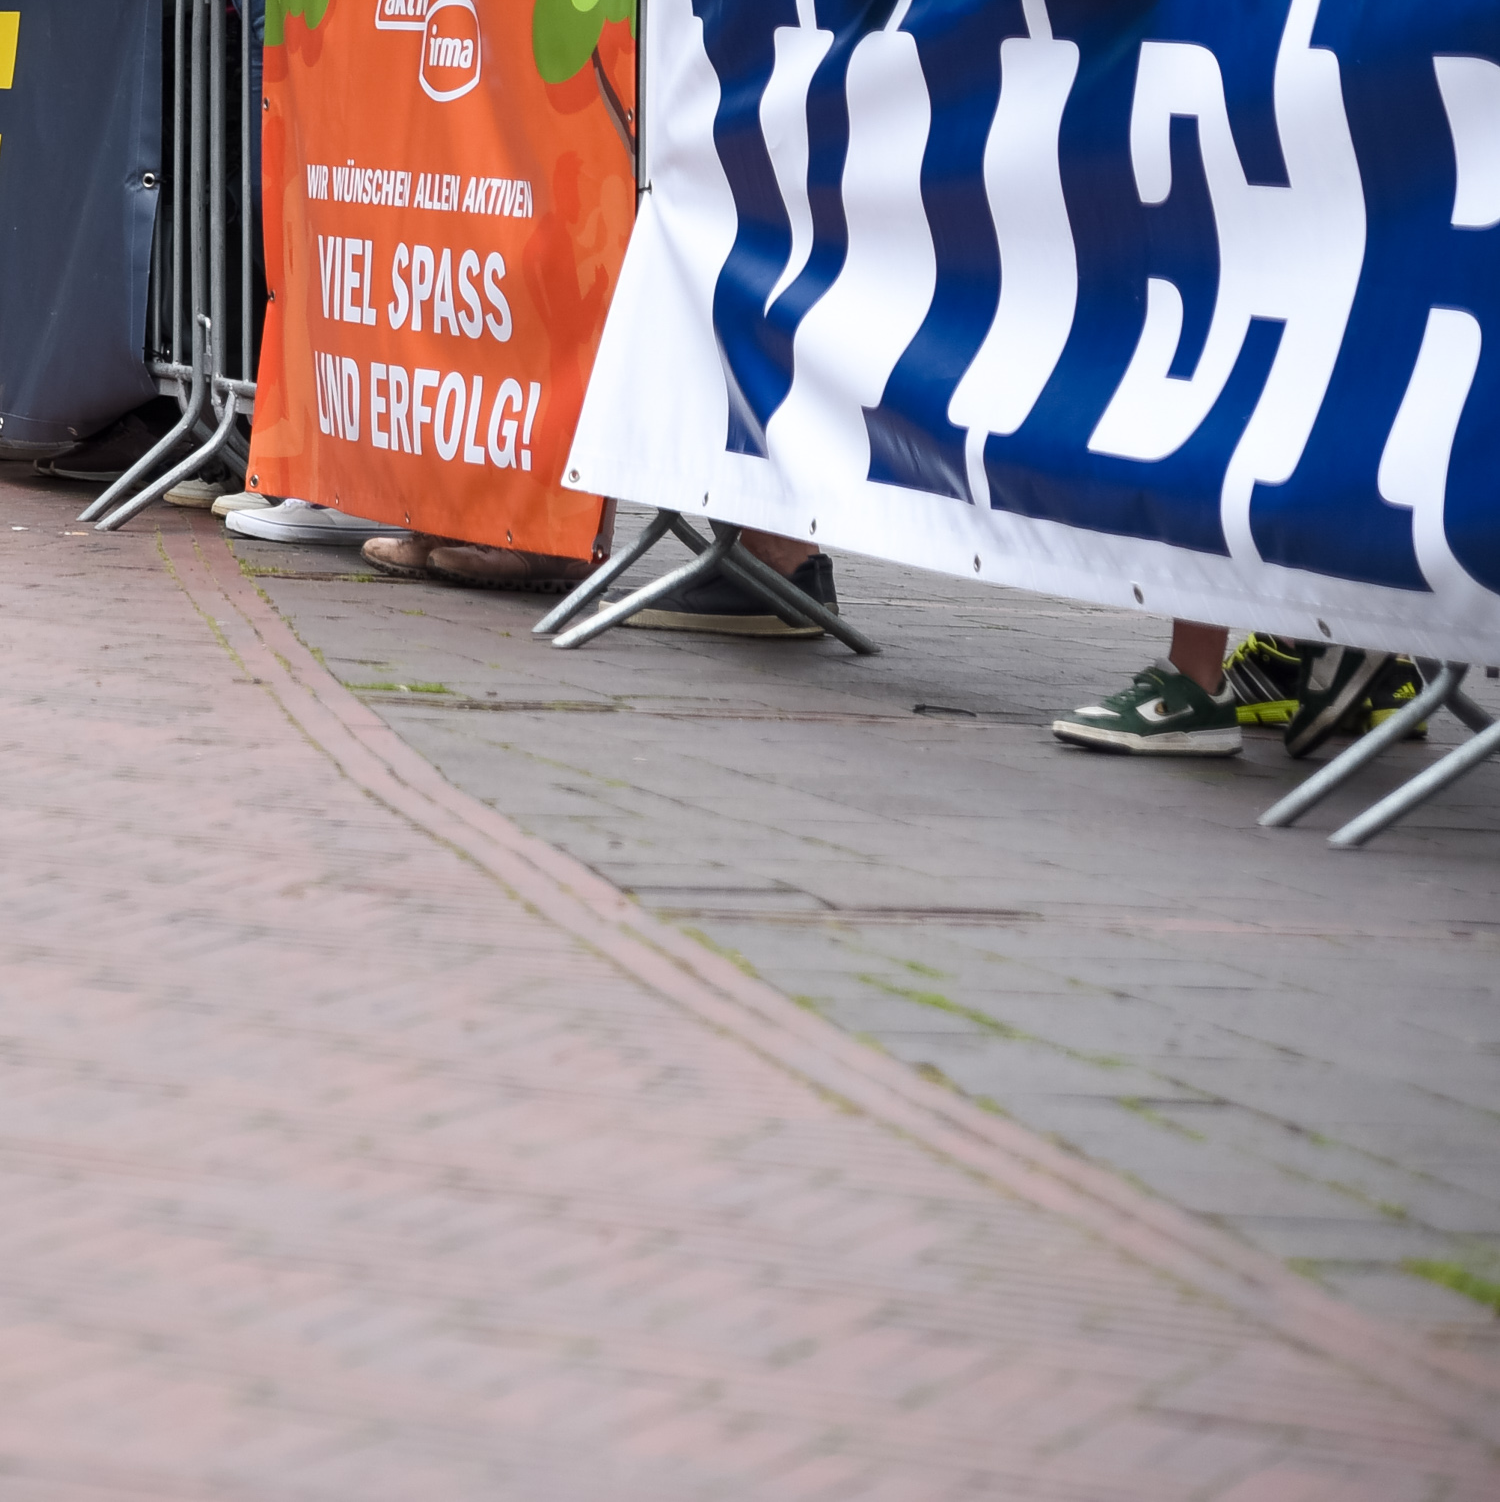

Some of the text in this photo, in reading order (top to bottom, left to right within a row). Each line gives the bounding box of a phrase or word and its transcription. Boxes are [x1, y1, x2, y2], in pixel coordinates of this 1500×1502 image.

[428, 24, 474, 69] irma
[307, 158, 533, 219] WIR WÜNSCHEN ALLEN AKTIVEN
[318, 234, 513, 343] VIEL SPASS
[314, 350, 542, 472] UND ERFOLG!
